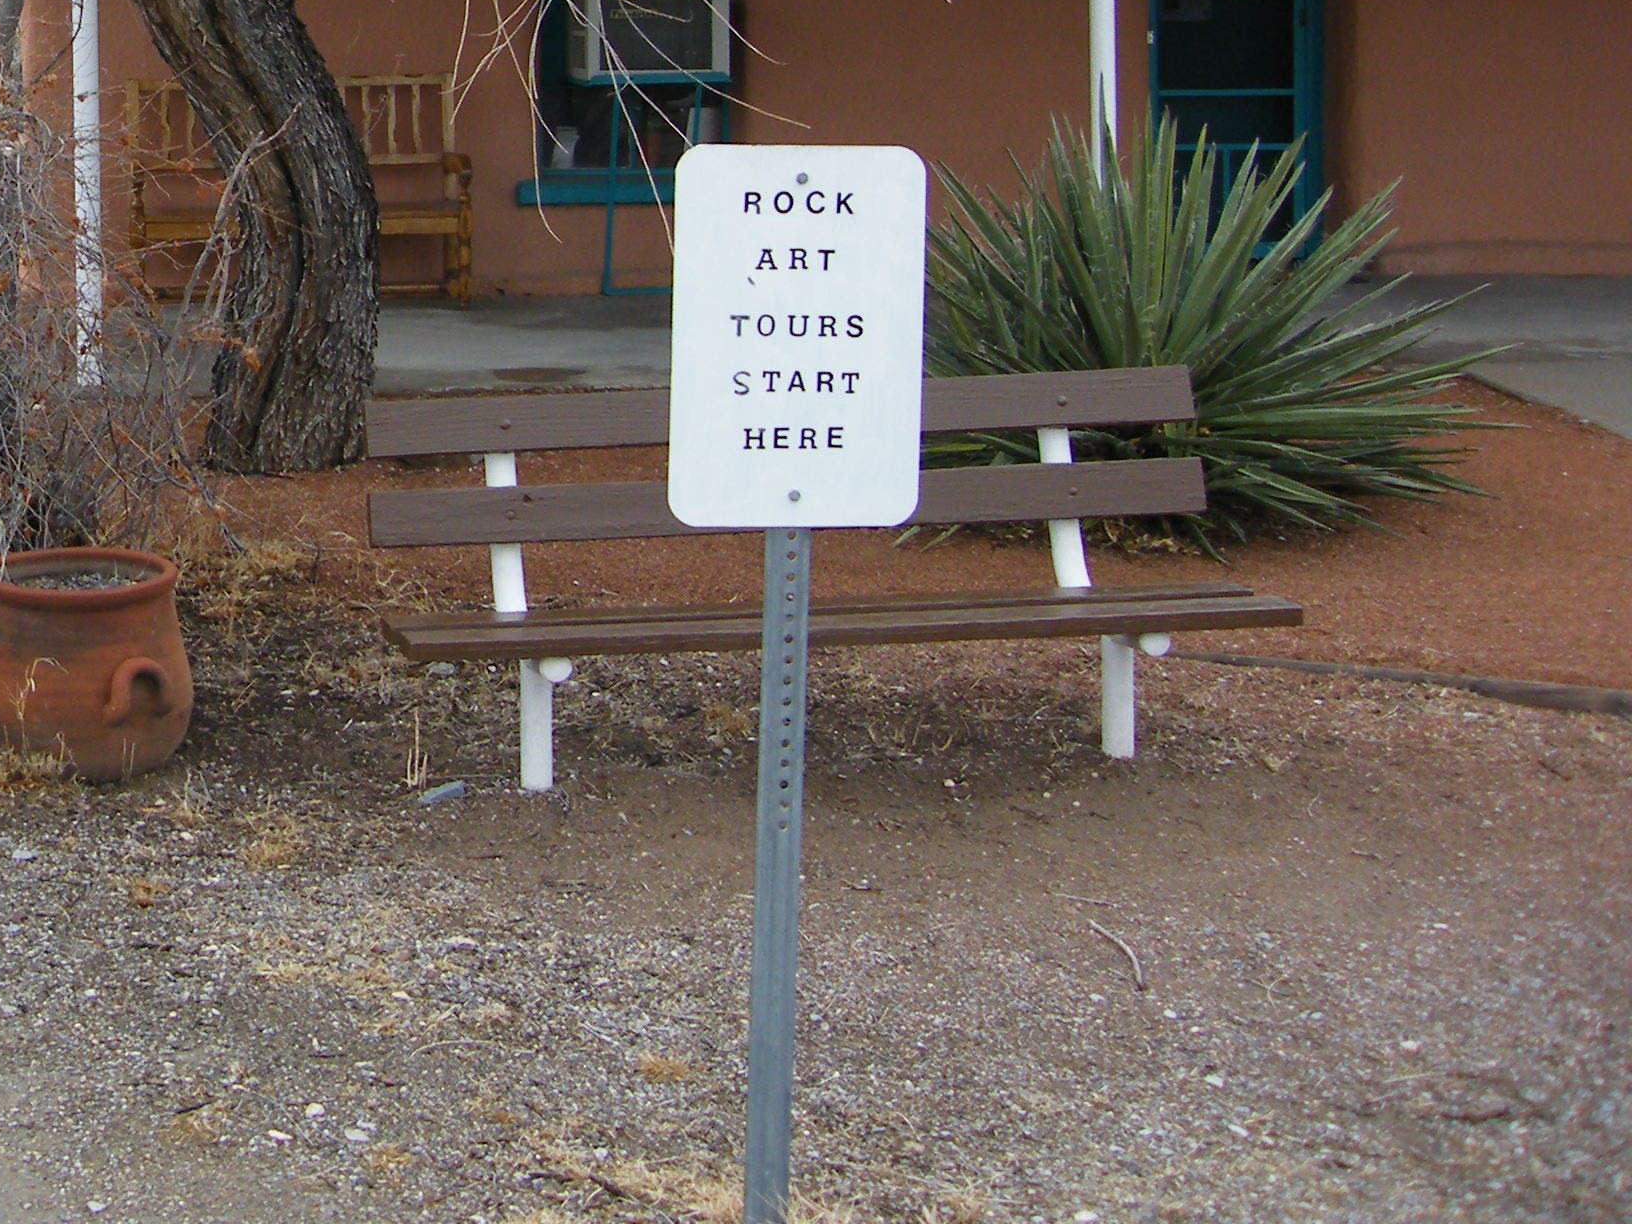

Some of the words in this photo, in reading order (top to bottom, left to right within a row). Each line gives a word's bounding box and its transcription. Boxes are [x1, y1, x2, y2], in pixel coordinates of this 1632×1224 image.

[743, 190, 855, 215] ROCK
[754, 247, 836, 271] ART
[729, 313, 864, 338] TOURS
[732, 370, 860, 396] START
[742, 426, 845, 450] HERE
